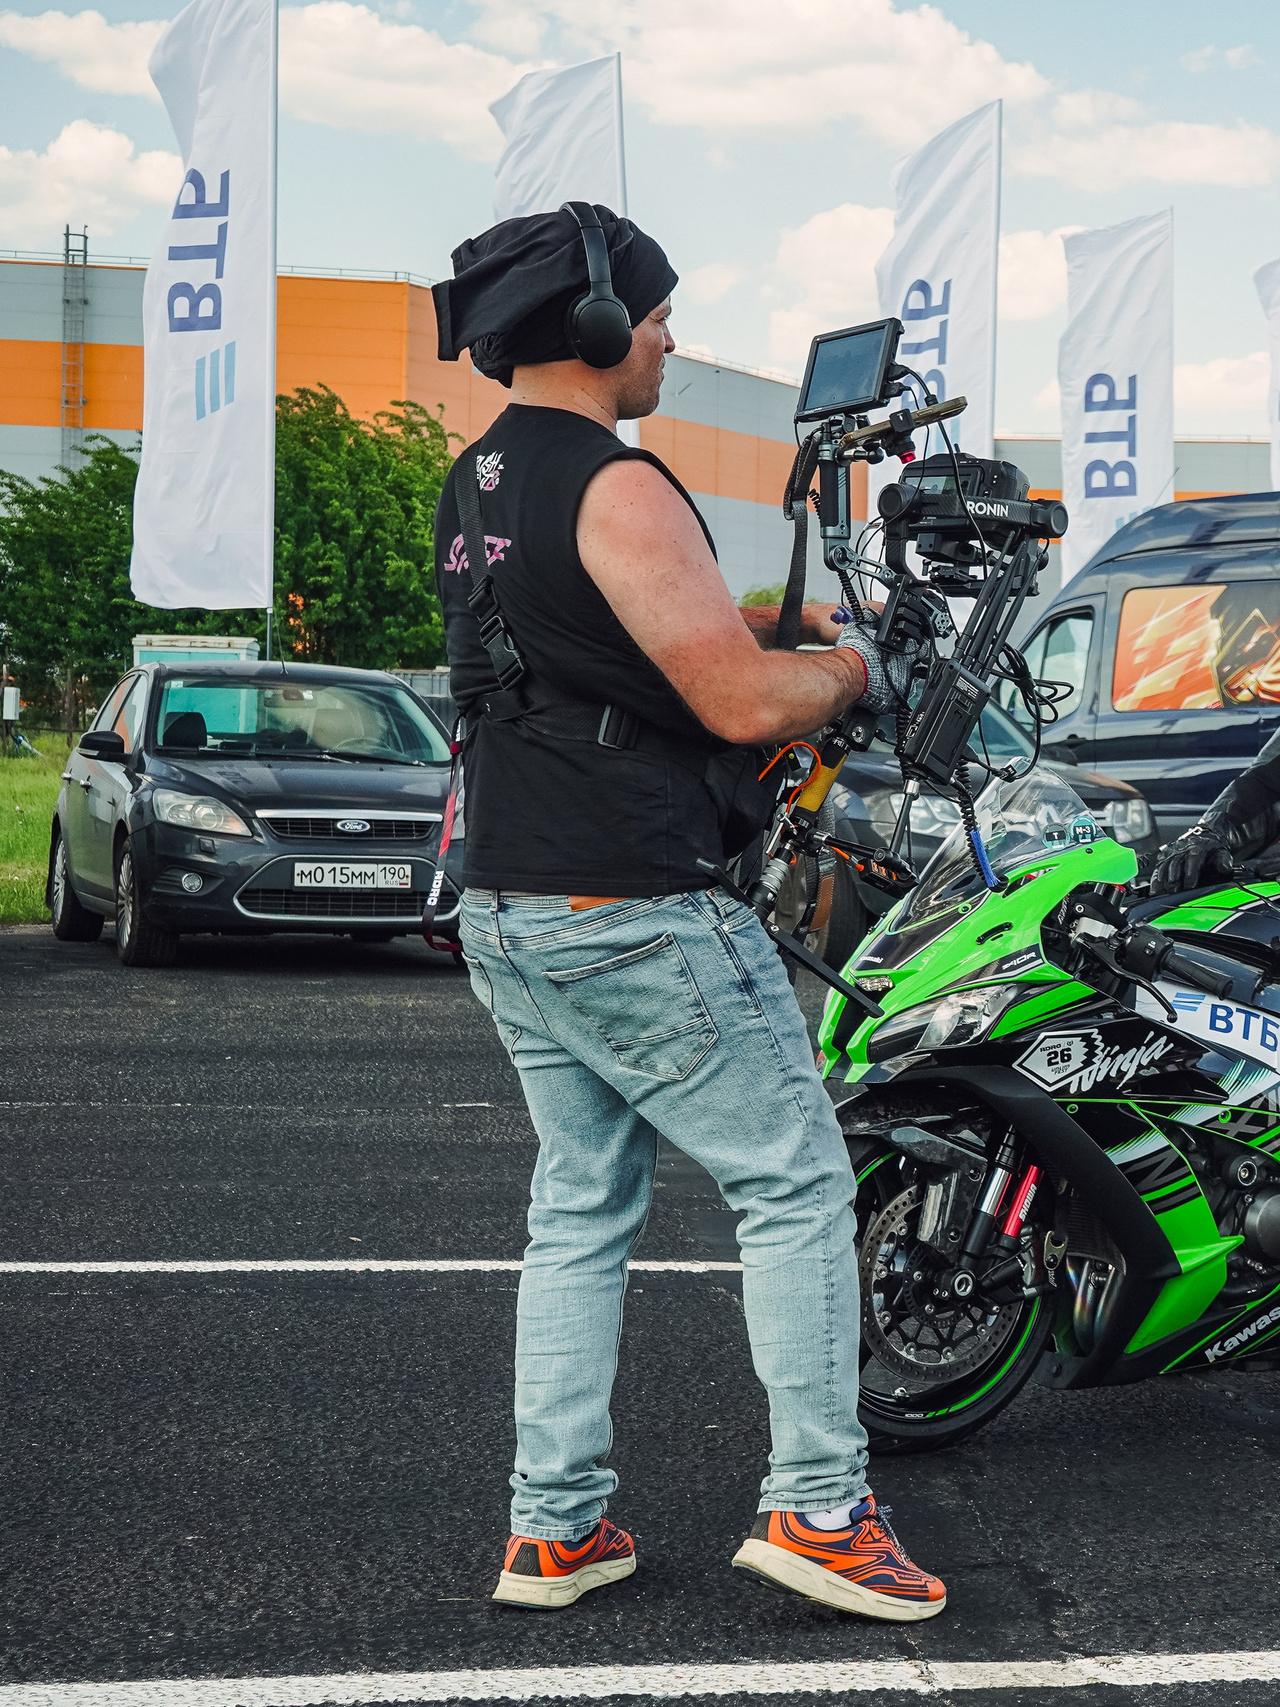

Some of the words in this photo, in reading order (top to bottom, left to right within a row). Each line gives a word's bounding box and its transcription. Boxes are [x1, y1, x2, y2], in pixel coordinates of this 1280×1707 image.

[966, 501, 1009, 517] RONIN
[343, 821, 363, 831] Ford
[379, 866, 406, 880] 190
[1209, 1003, 1280, 1052] ВТБ
[1046, 1047, 1072, 1067] 26
[1069, 1030, 1175, 1094] Ninja
[1018, 1183, 1038, 1222] SHOWA
